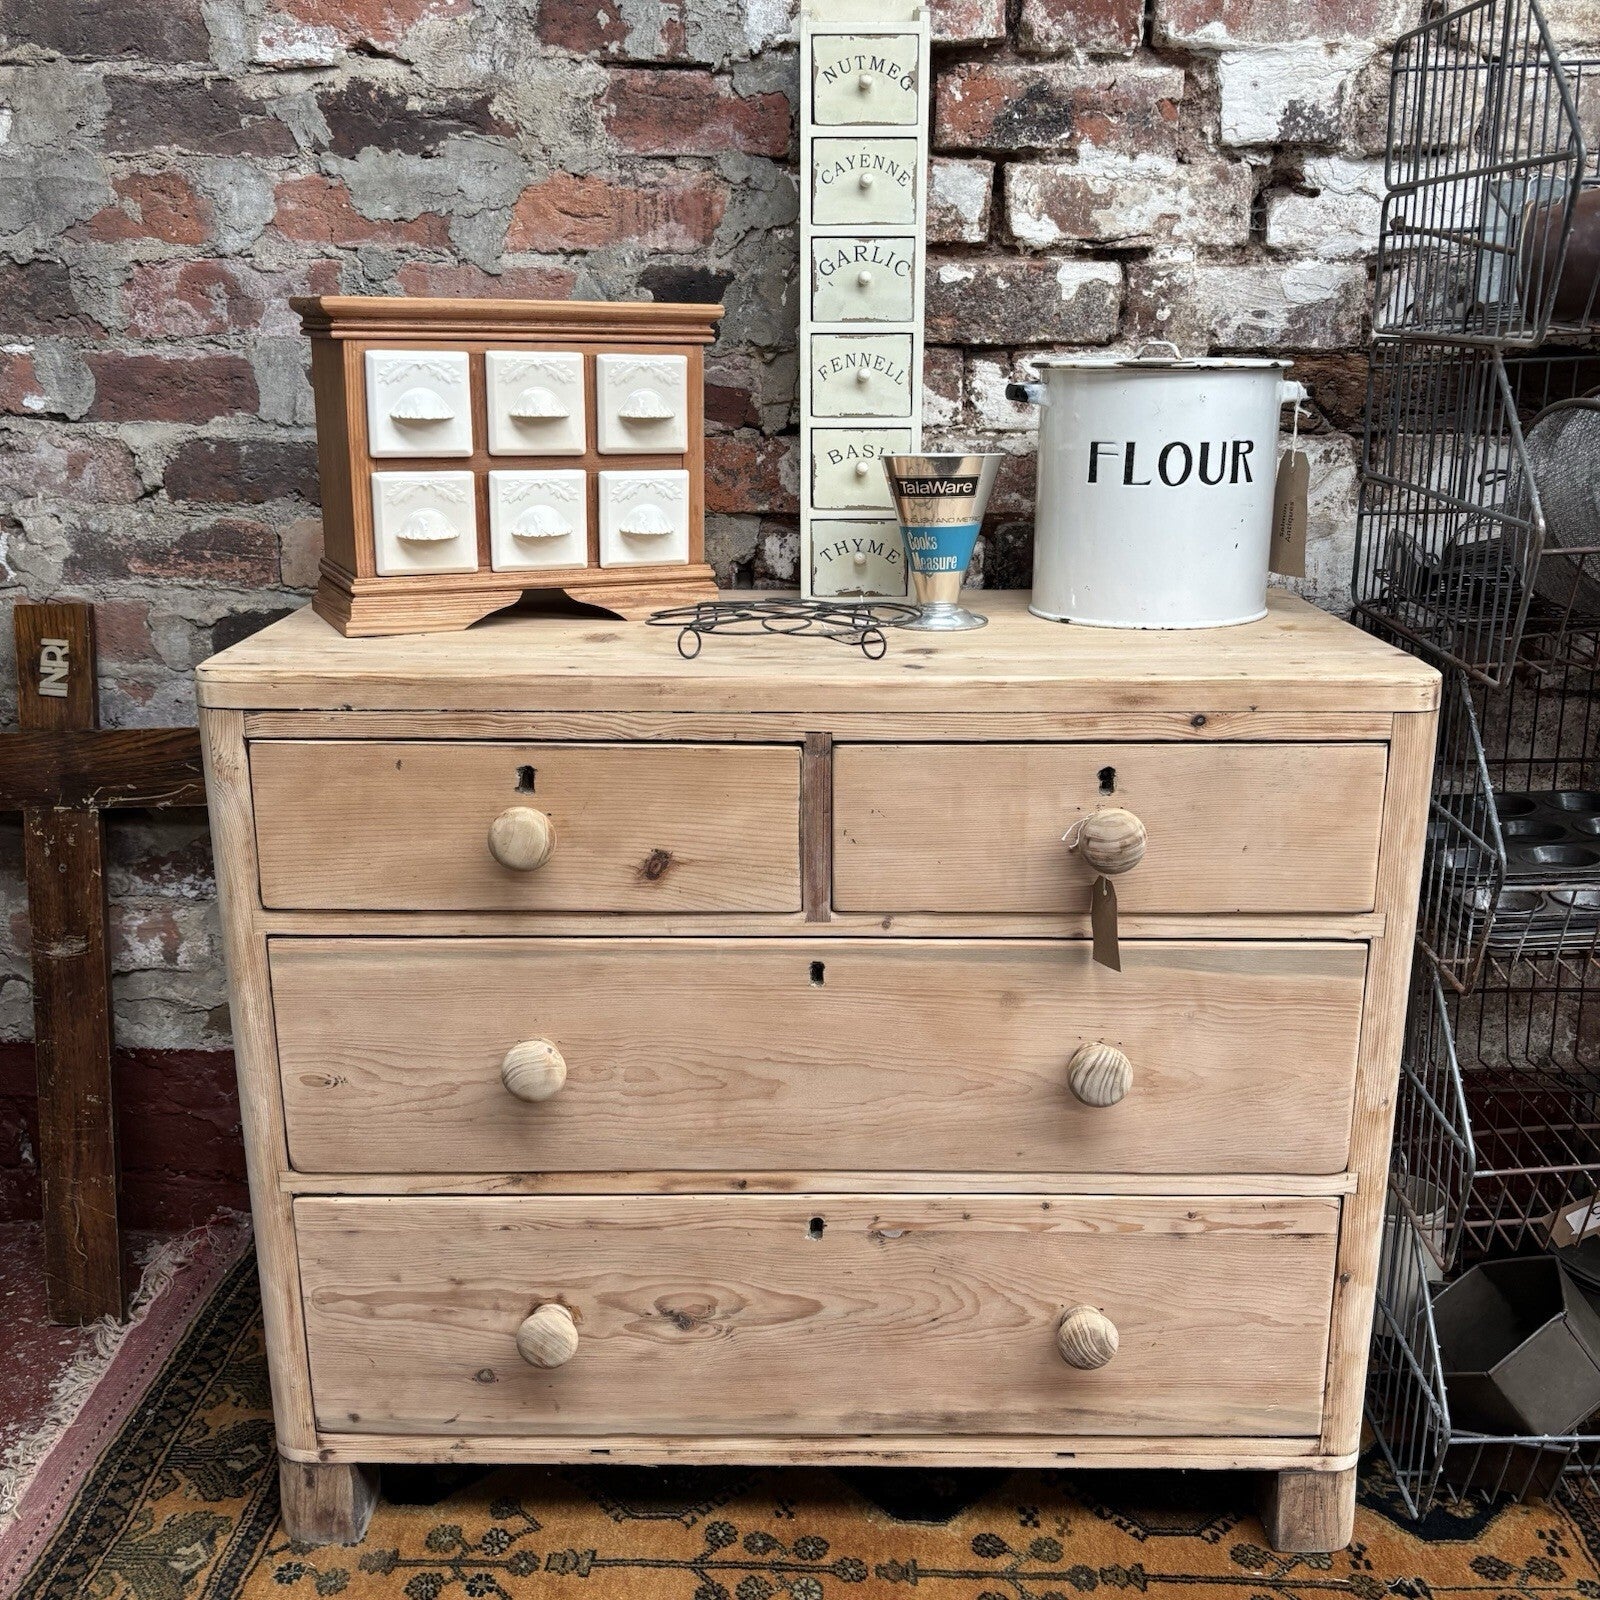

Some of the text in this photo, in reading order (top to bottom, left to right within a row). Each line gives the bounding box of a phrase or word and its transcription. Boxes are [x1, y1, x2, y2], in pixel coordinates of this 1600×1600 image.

[821, 54, 915, 92] NUTMEG
[820, 153, 911, 188] CAYENNE
[818, 244, 911, 277] GARLIC
[817, 352, 904, 386] FENNELL
[1087, 440, 1254, 487] FLOUR
[900, 480, 973, 495] TalaWare
[1285, 501, 1295, 543] Antiques
[819, 538, 901, 565] THYME
[907, 531, 938, 550] Cooks
[912, 552, 957, 571] Measure
[39, 638, 69, 698] INRI
